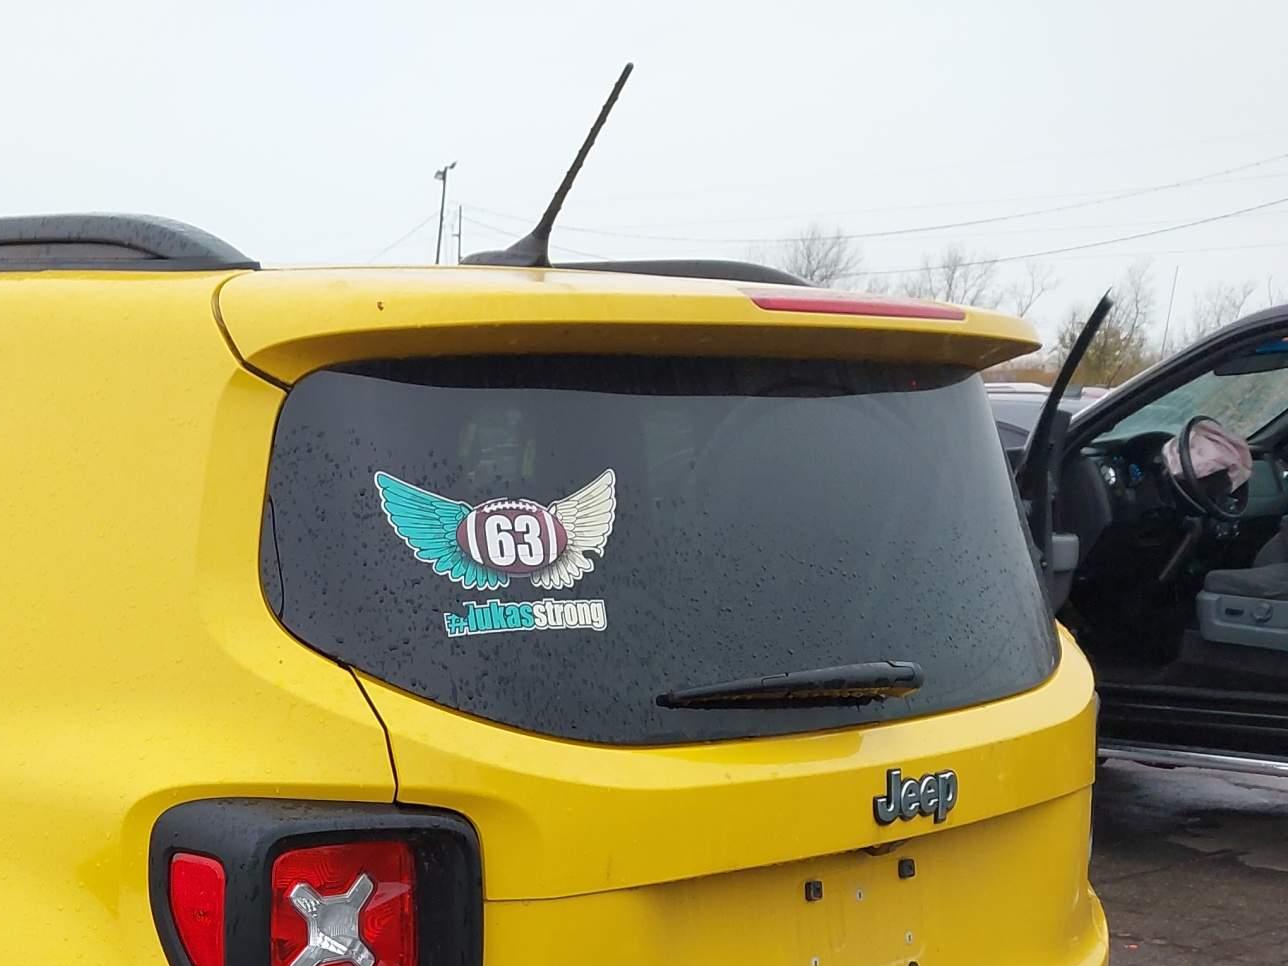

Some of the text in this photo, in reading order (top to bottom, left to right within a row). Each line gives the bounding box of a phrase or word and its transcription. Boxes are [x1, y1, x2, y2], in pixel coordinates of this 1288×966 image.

[485, 514, 544, 566] 63
[447, 600, 606, 635] #lukasstrong
[873, 768, 958, 826] Jeep
